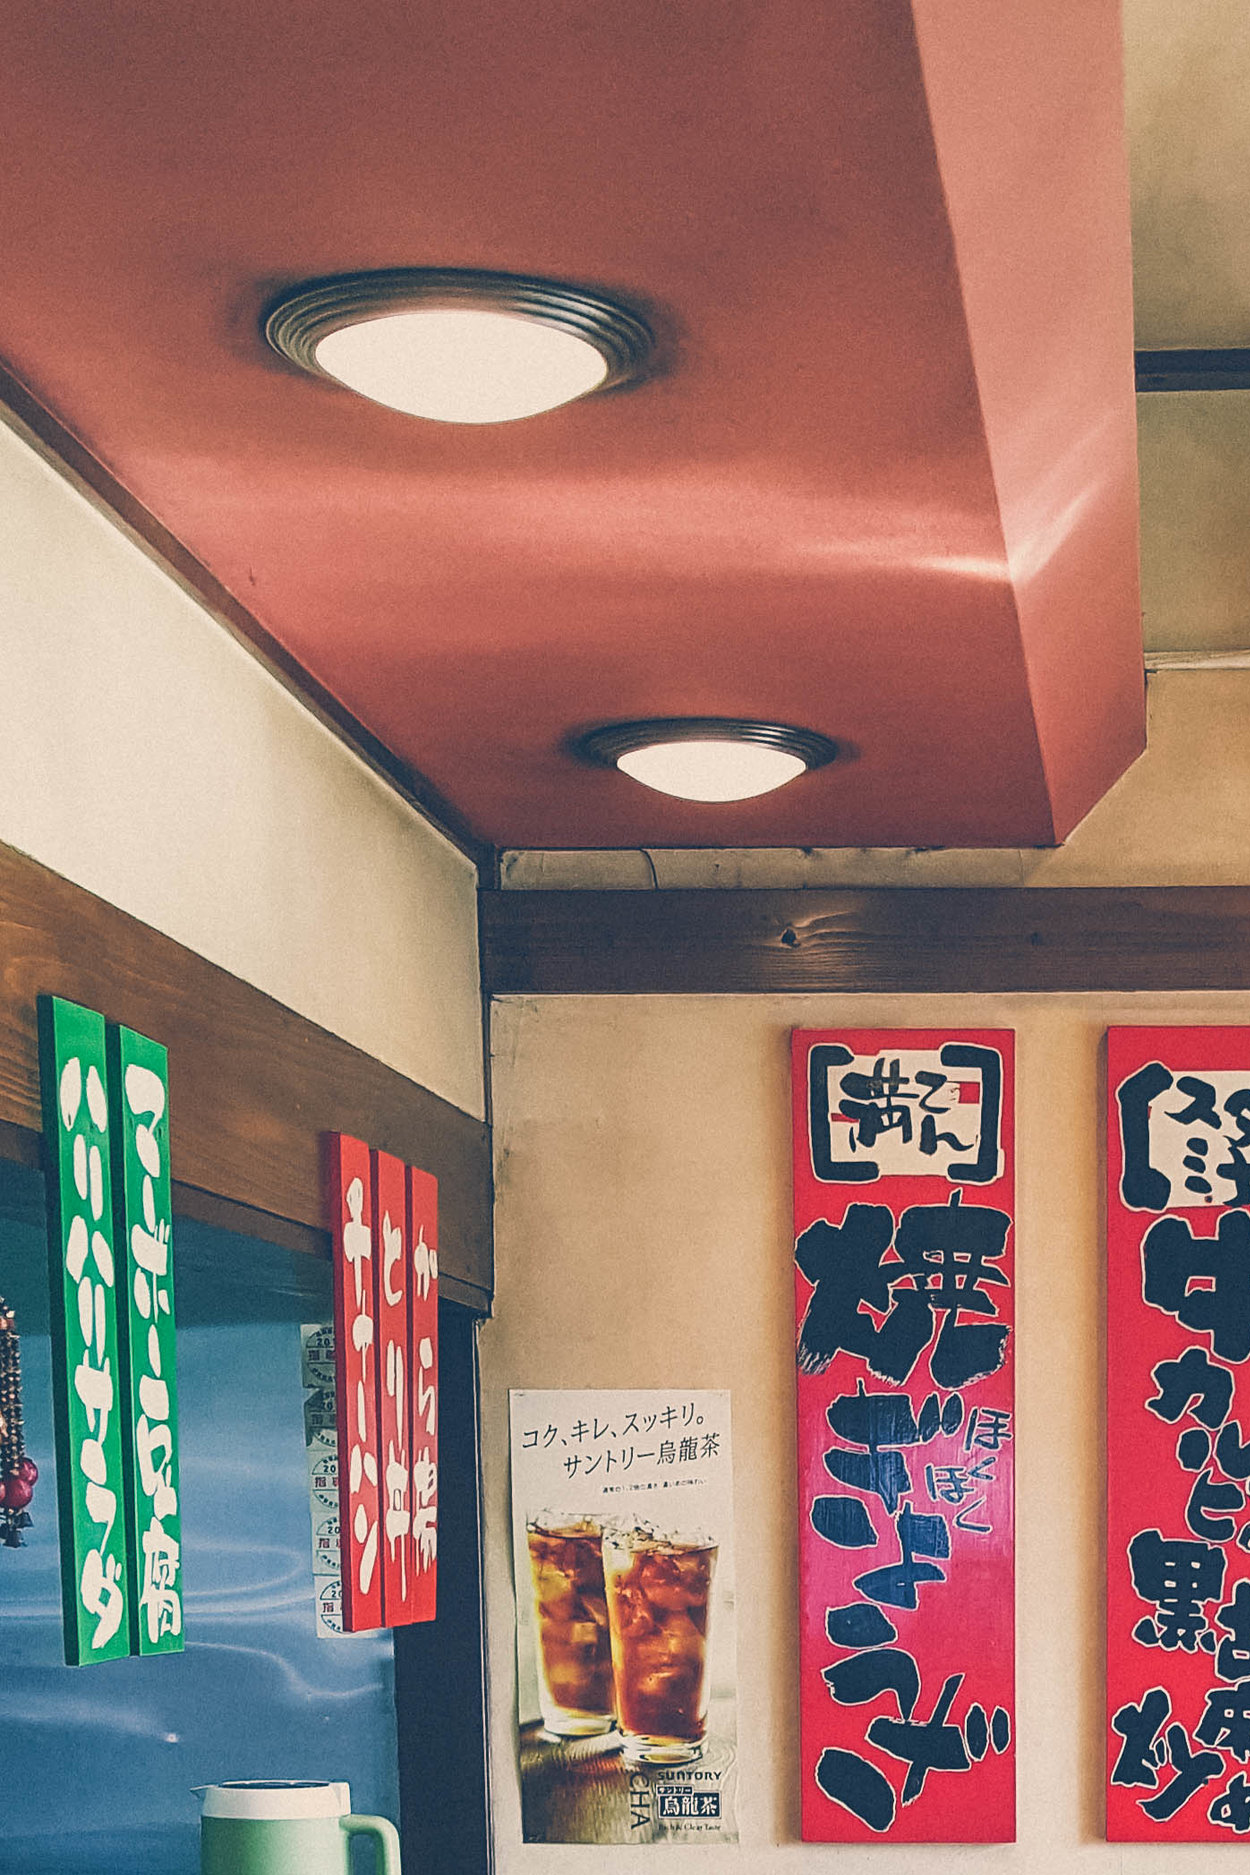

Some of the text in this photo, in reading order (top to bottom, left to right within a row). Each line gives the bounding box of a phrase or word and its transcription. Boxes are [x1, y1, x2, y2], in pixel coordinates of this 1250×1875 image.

[60, 1056, 123, 1650] ハリハリサラダ
[124, 1063, 181, 1644] マーボー豆腐
[343, 1177, 378, 1595] チャーハン
[522, 1402, 706, 1449] コク、キレ、スッキリ。
[562, 1432, 721, 1479] サントリー烏龍茶
[925, 1407, 1013, 1534] ほくほく
[657, 1770, 722, 1781] SUNTORY
[662, 1796, 718, 1816] 烏龍茶
